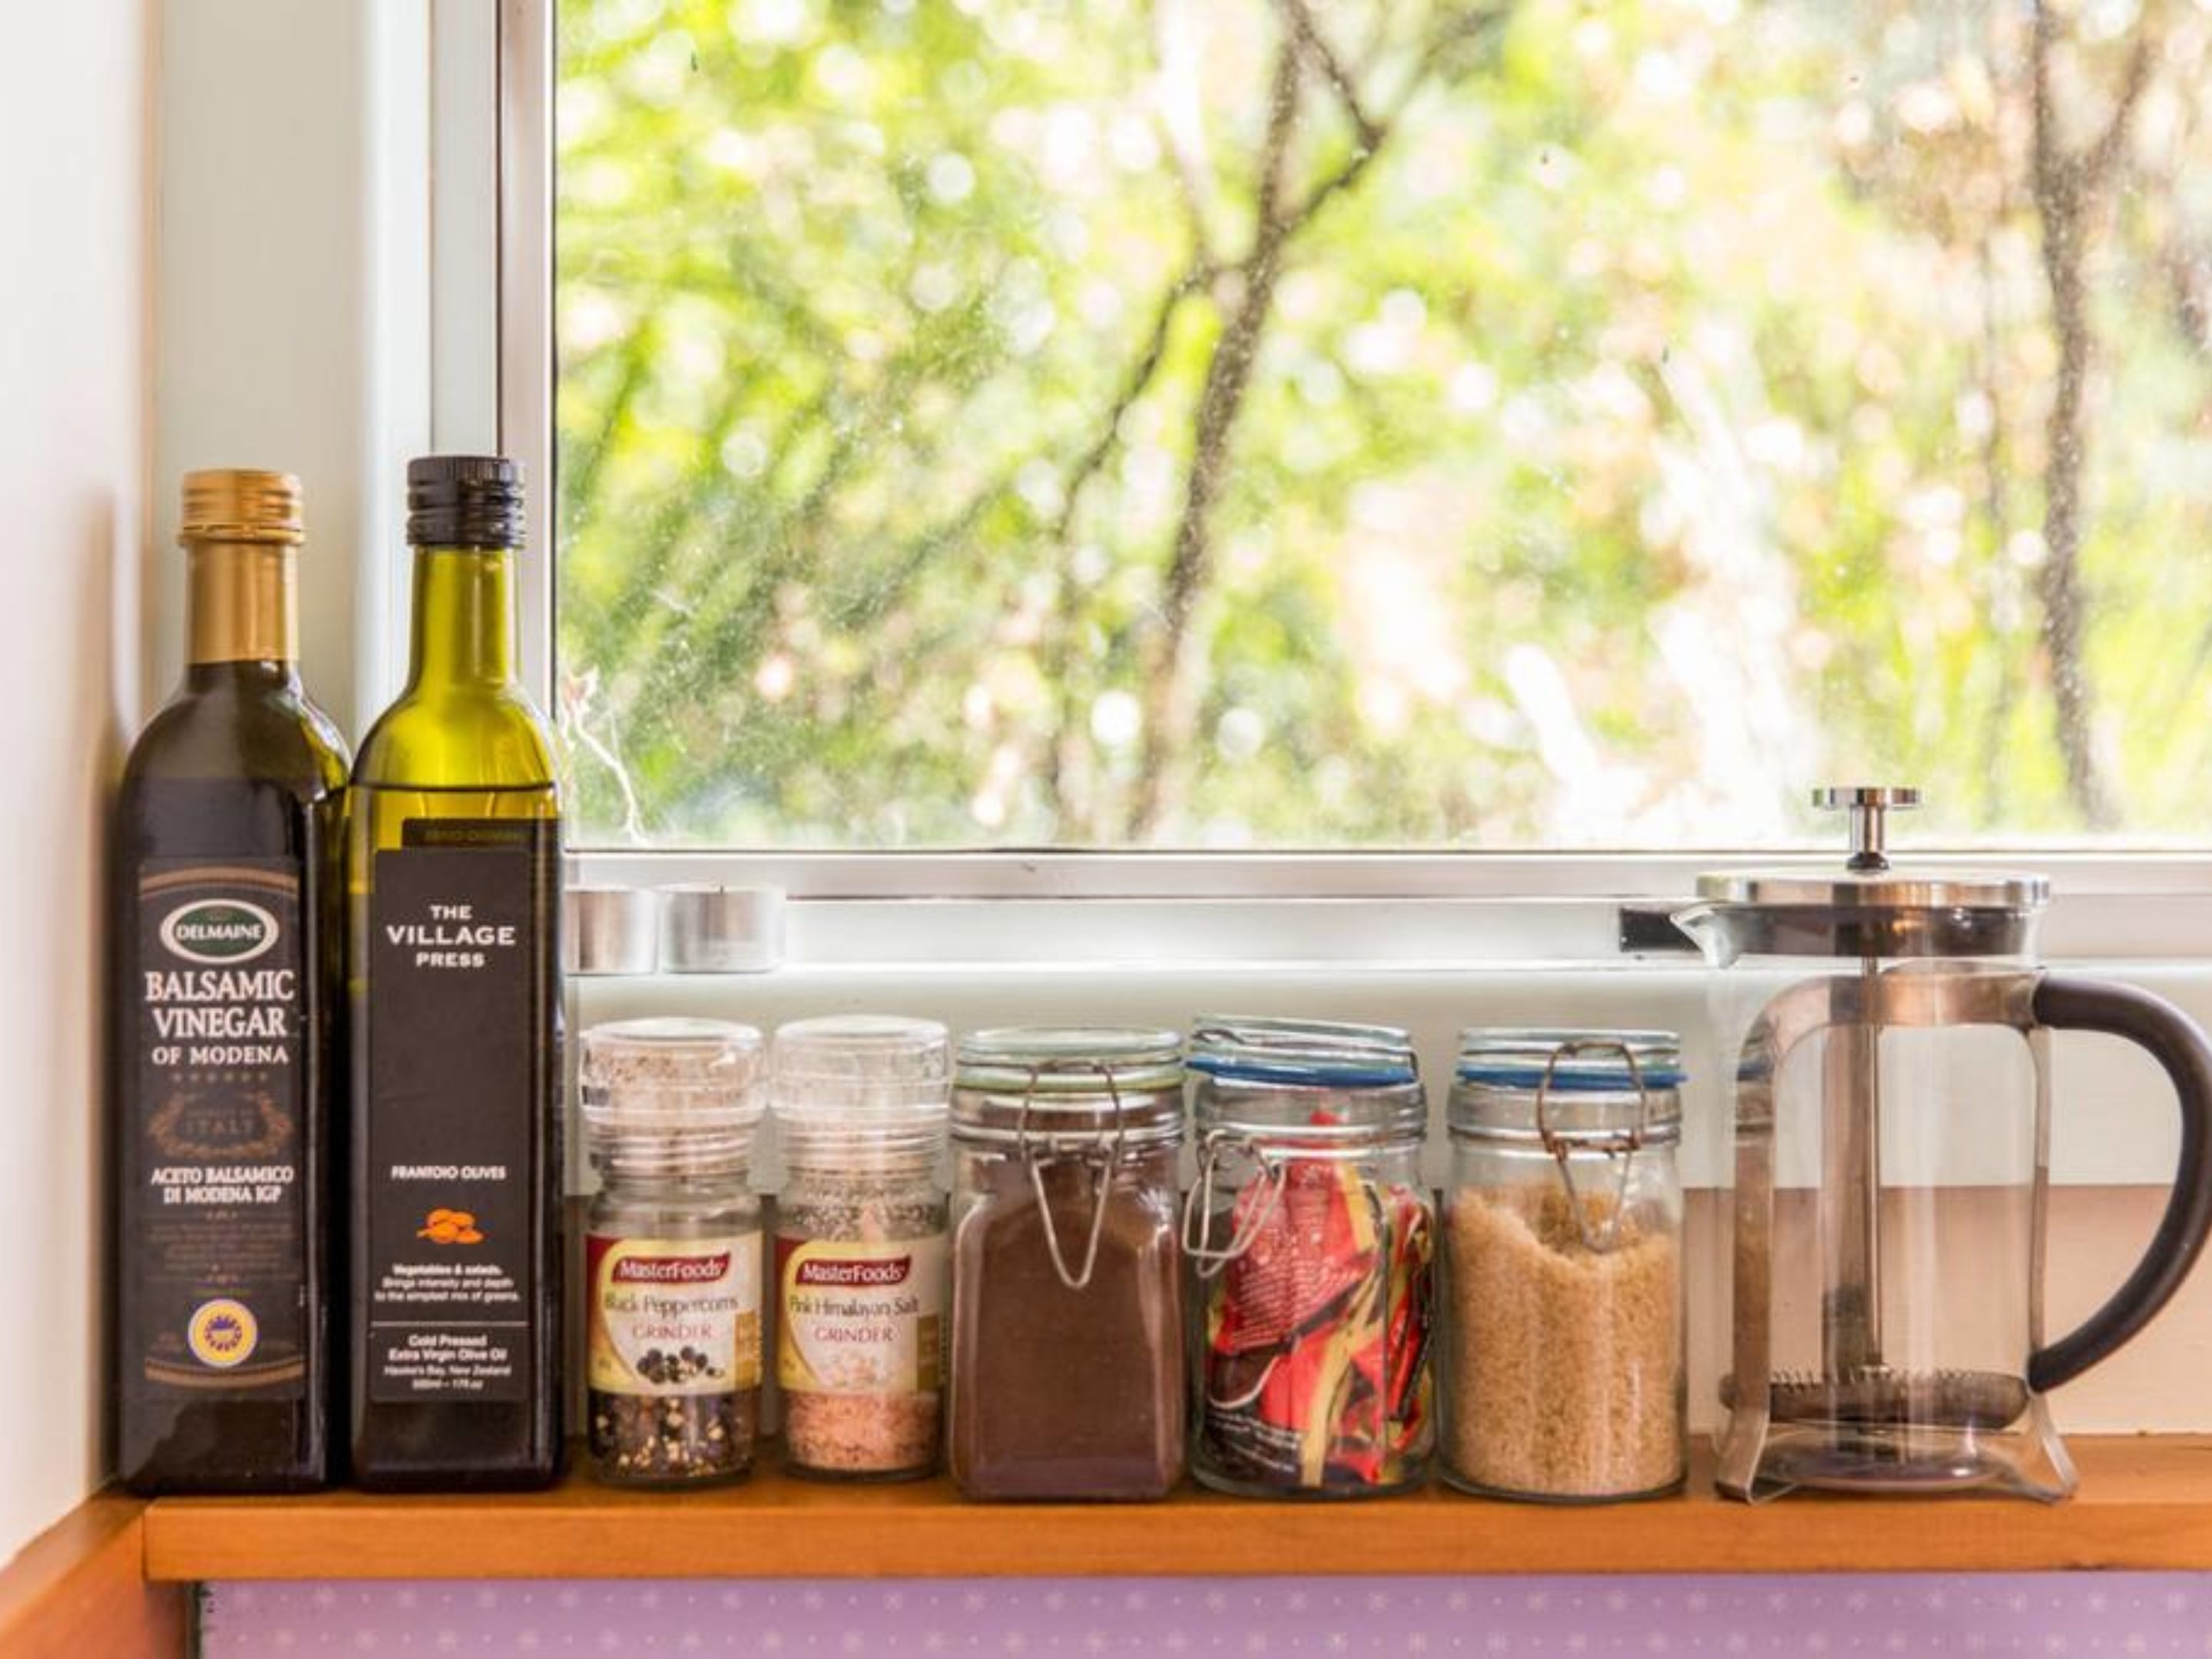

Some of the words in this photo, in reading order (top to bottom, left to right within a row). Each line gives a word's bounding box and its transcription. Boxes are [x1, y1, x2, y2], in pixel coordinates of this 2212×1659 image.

[429, 905, 473, 920] THE
[175, 923, 263, 939] DELMAINE
[386, 925, 517, 945] VILLAGE
[416, 952, 486, 968] PRESS
[144, 969, 295, 1002] BALSAMIC
[152, 1007, 289, 1038] VINEGAR
[151, 1046, 183, 1065] OF
[190, 1045, 290, 1065] MODENA
[151, 1167, 203, 1185] ACETO
[205, 1165, 294, 1184] BALSAMICO
[391, 1165, 459, 1181] FRANTOIO
[461, 1165, 507, 1181] OLIVES
[164, 1187, 181, 1204] DI
[184, 1187, 253, 1204] MODENA
[256, 1185, 283, 1204] IGP
[620, 1259, 721, 1280] MasterFoods
[803, 1262, 901, 1283] MasterFoods
[605, 1292, 637, 1311] Black
[644, 1294, 738, 1320] Peppercorns
[814, 1298, 892, 1319] Himalayan
[893, 1296, 919, 1313] Salt
[409, 1334, 437, 1346] Cold
[439, 1334, 488, 1346] Pressed
[632, 1323, 712, 1339] GRINDER
[814, 1325, 896, 1342] GRINDER
[388, 1348, 420, 1361] Extra
[422, 1349, 456, 1363] Virgin
[458, 1348, 488, 1360] Olive
[489, 1348, 508, 1360] Oil
